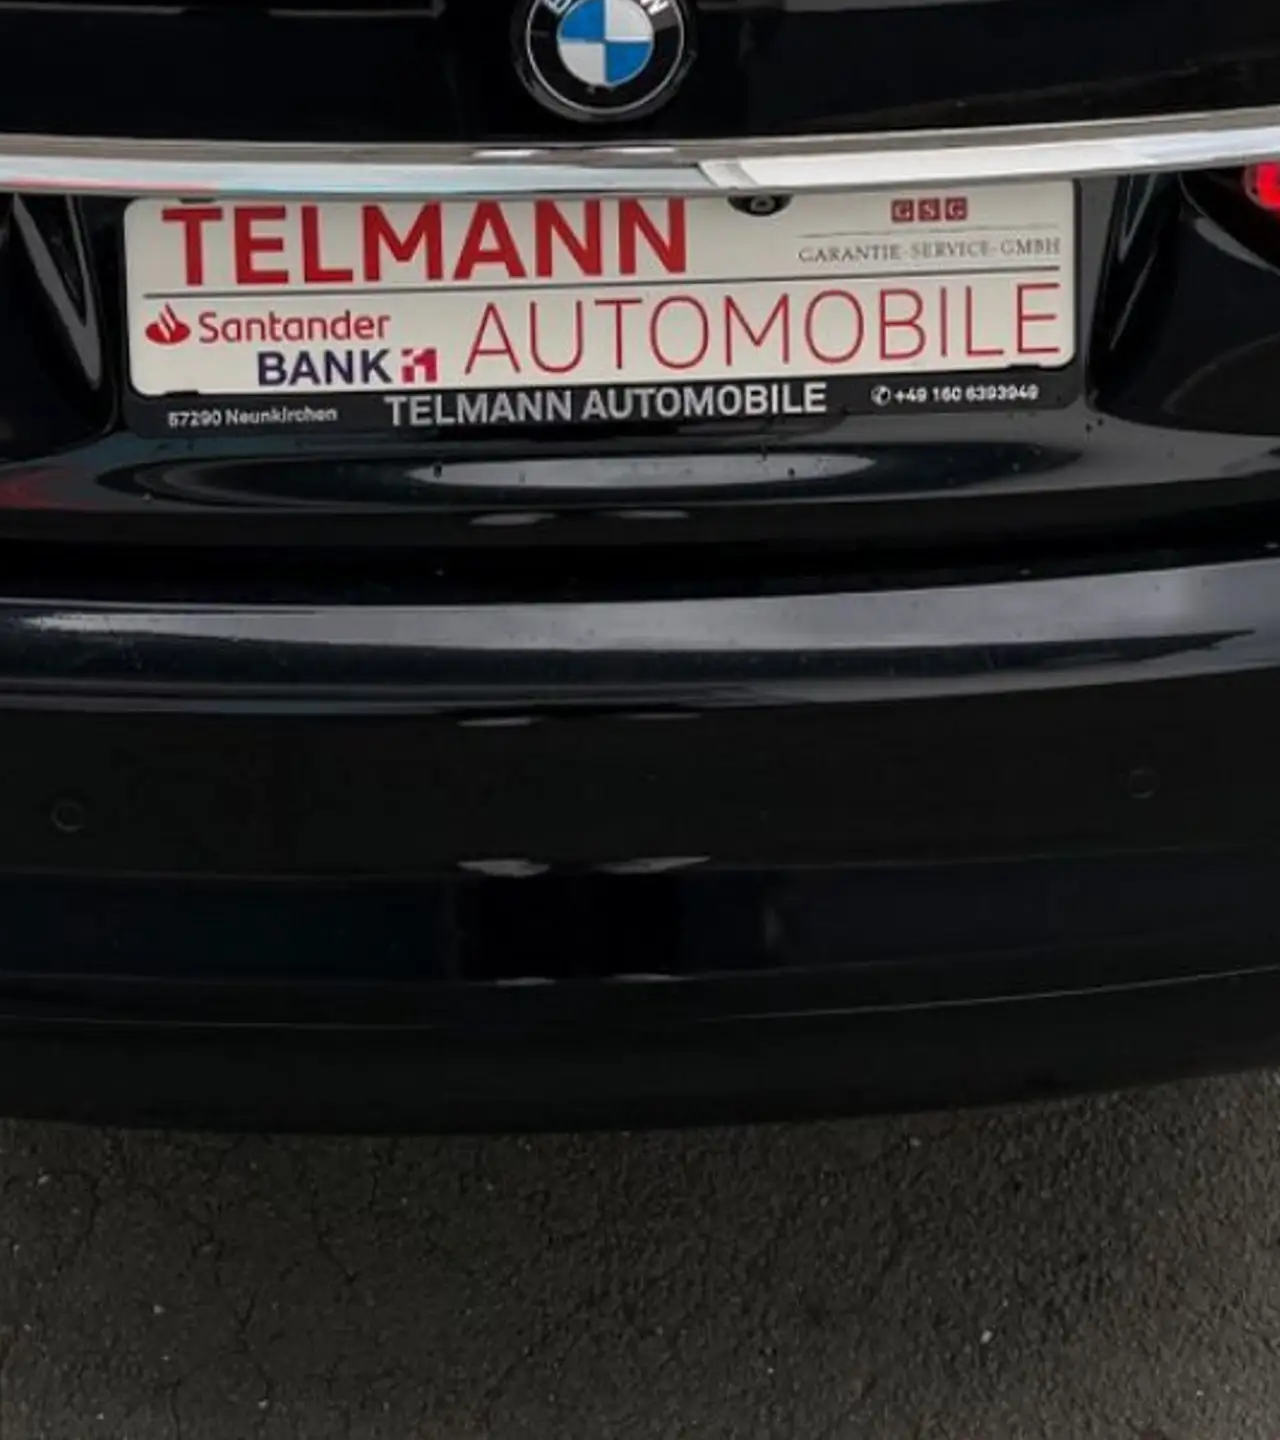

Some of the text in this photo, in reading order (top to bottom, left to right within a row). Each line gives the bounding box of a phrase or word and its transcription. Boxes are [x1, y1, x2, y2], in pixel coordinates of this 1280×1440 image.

[161, 196, 687, 286] TELMANN
[198, 310, 391, 344] Santander
[465, 282, 1061, 374] AUTOMOBILE
[384, 381, 828, 428] TELMANN AUTOMOBILE
[894, 386, 928, 404] +49
[932, 385, 962, 403] 160
[169, 405, 338, 429] 57290 Neunkirchen
